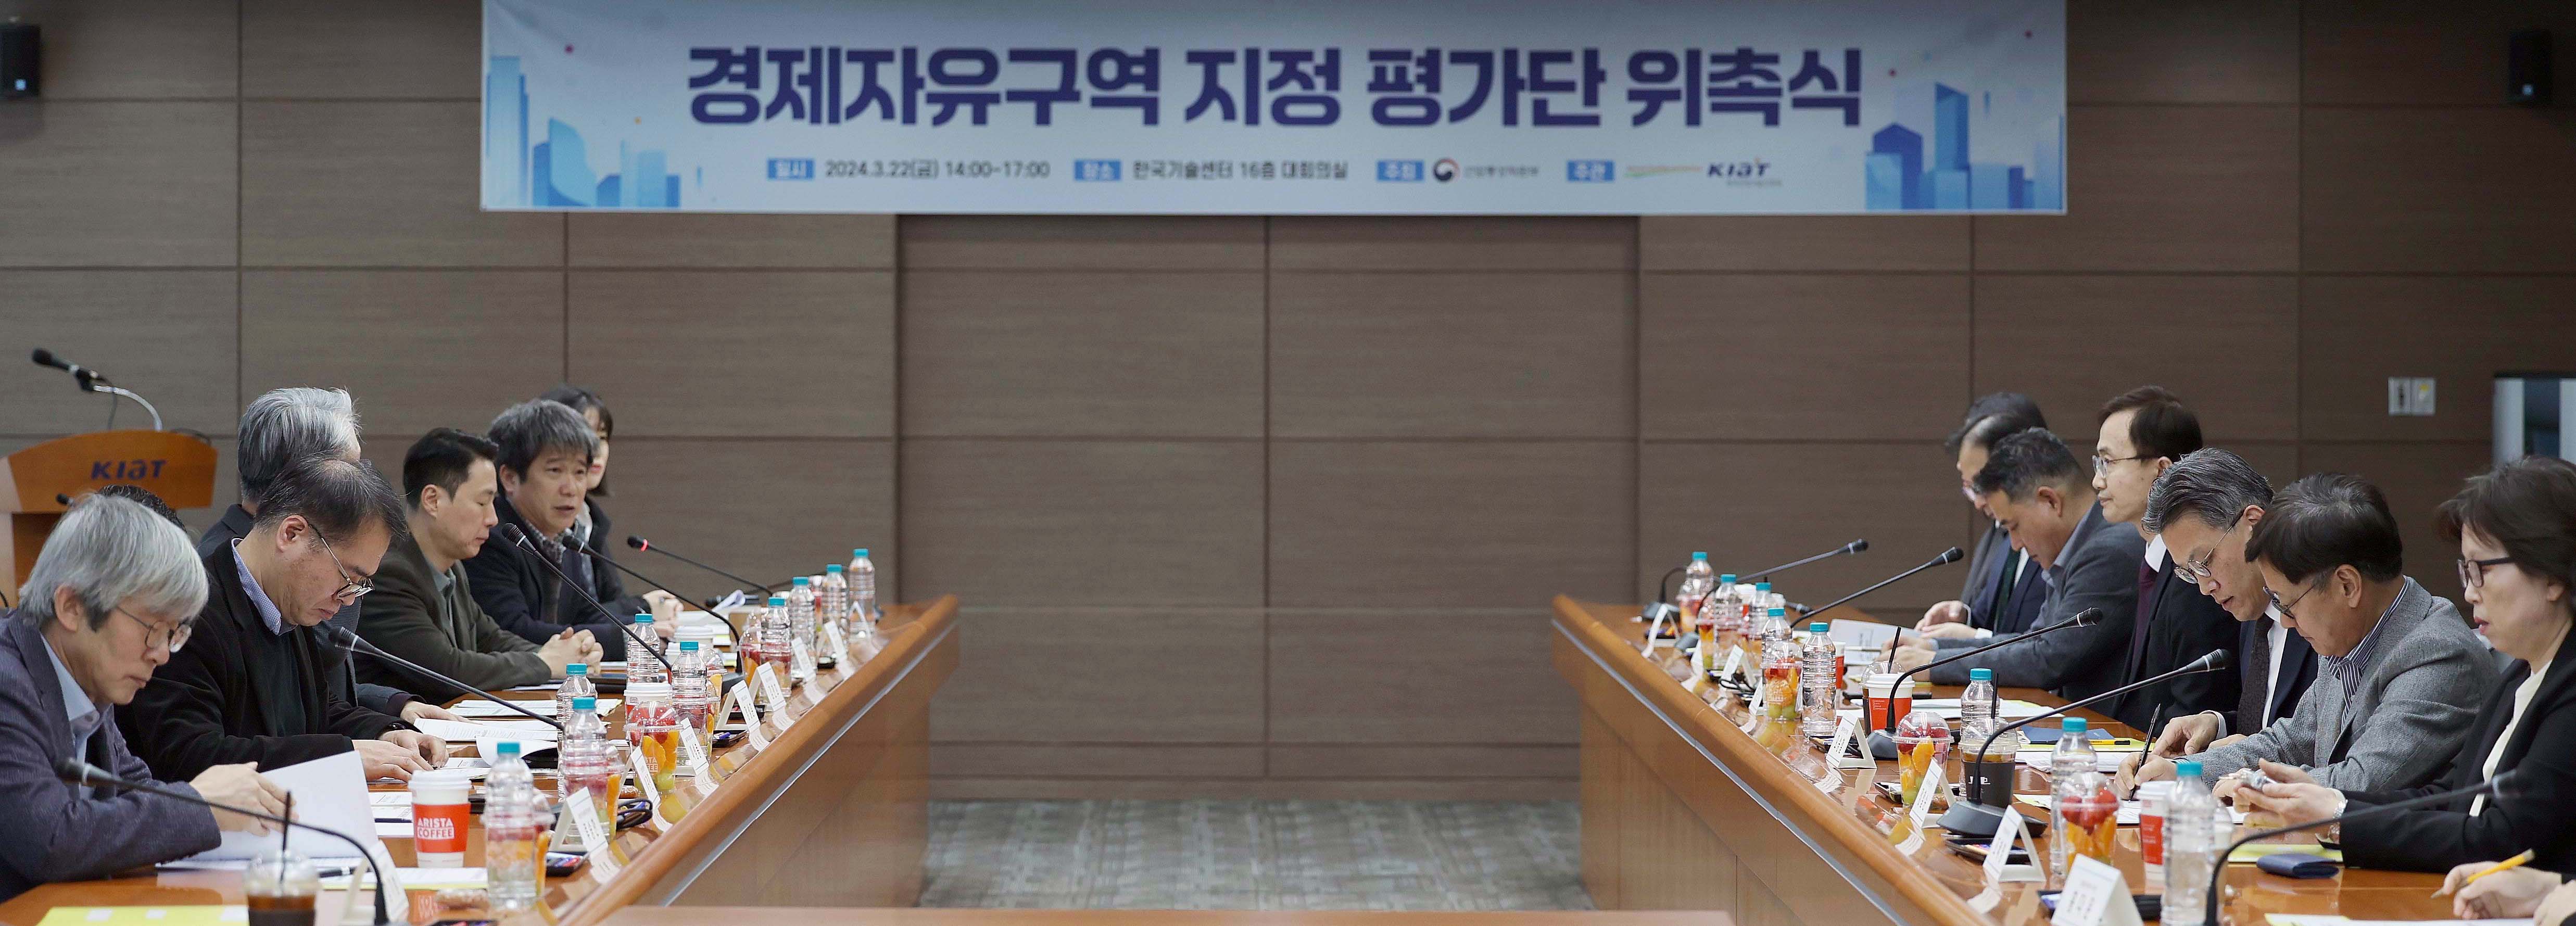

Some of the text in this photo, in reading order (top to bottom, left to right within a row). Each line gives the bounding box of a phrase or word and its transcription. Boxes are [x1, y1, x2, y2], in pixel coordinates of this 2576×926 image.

[689, 46, 1862, 126] 경제자유구역 지정 평가단 위촉식
[825, 160, 939, 178] 2024.3.22(금)
[1133, 161, 1233, 179] 한국기술센터
[1240, 161, 1276, 179] 16층
[1282, 161, 1348, 179] 대회의실
[418, 818, 453, 827] ARISTA
[419, 829, 453, 837] COFFEE
